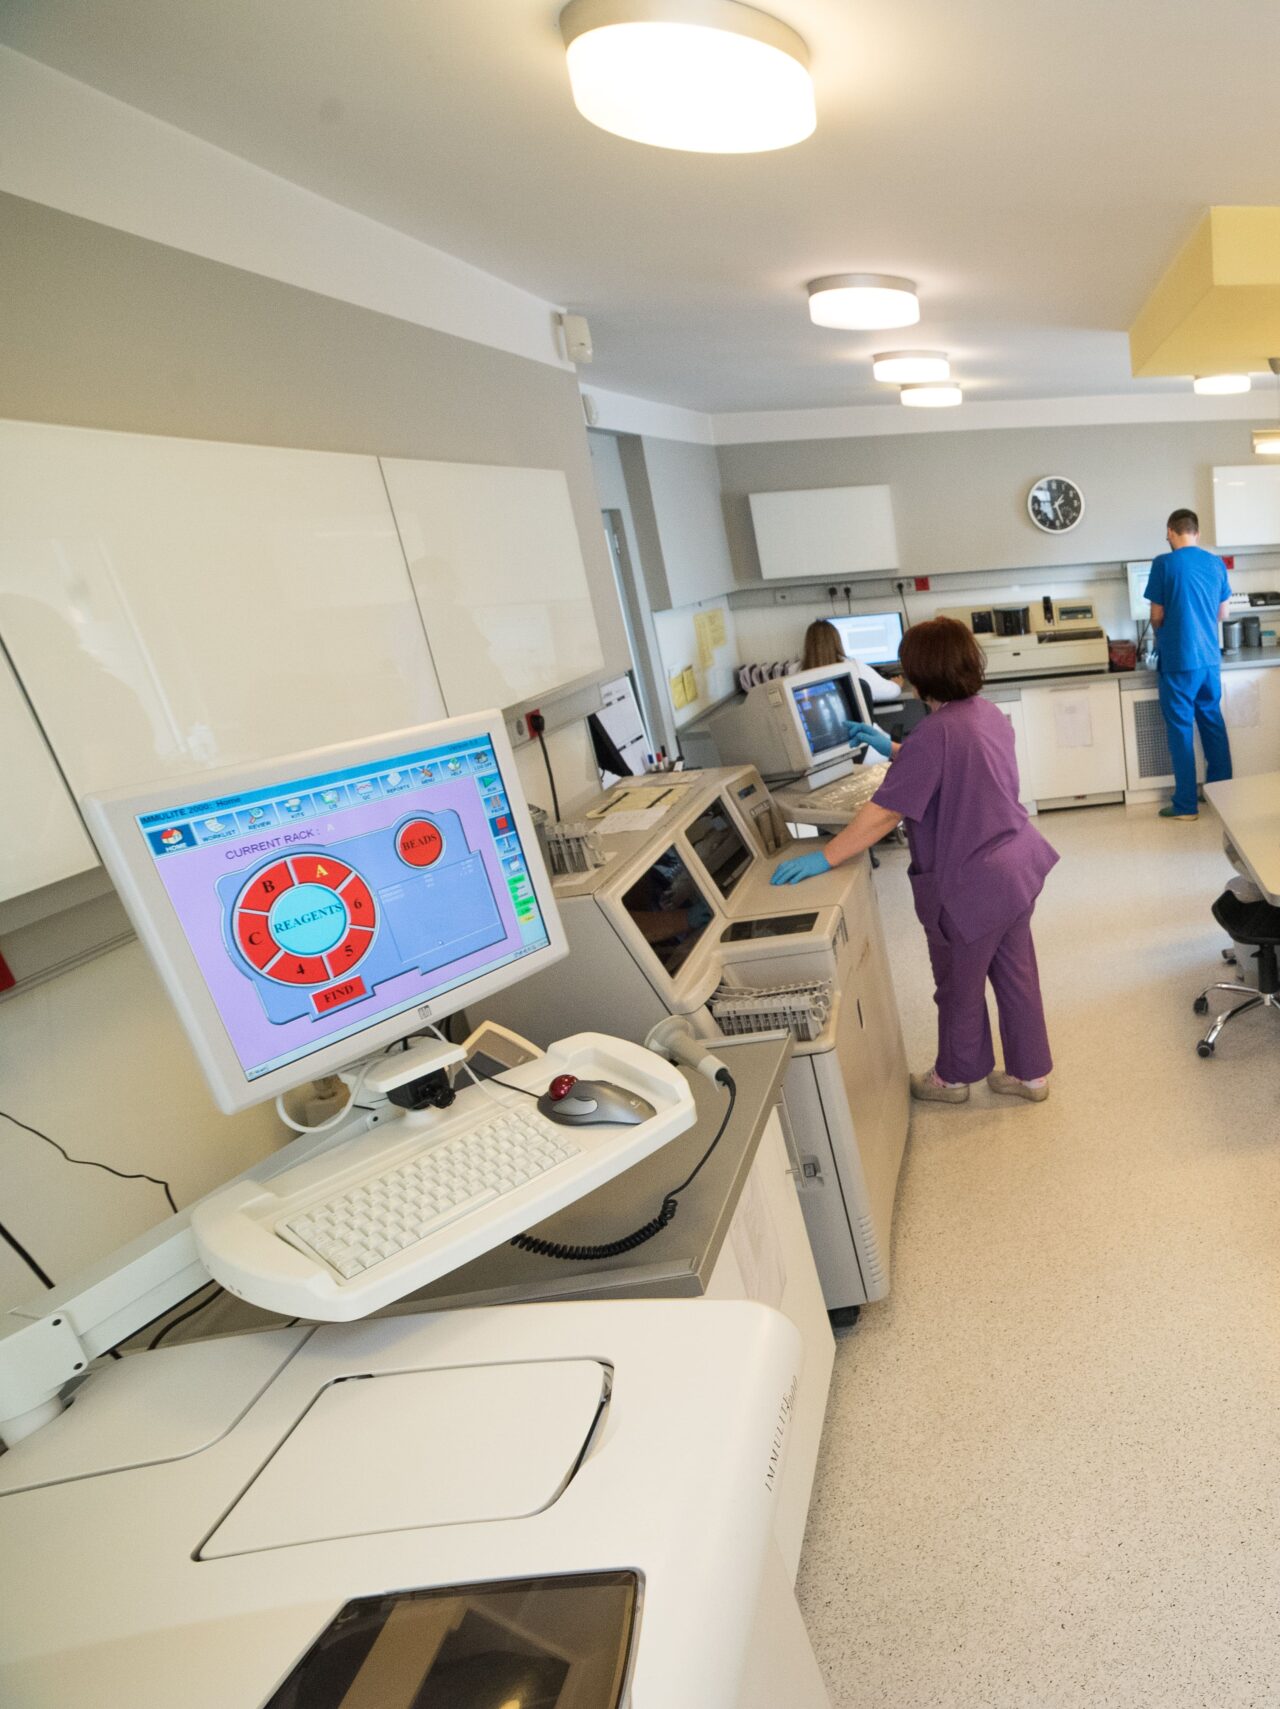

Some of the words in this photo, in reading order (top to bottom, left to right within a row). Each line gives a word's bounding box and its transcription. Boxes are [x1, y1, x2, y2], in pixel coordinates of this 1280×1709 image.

[140, 808, 186, 825] IMMULITE
[216, 797, 242, 807] Home
[248, 820, 272, 831] REVIEW
[202, 829, 237, 842] WORKLIST
[402, 833, 437, 851] BEADS
[225, 837, 283, 860] CURRENT
[315, 864, 328, 878] A
[262, 880, 275, 894] B
[353, 899, 363, 910] 6
[273, 903, 343, 934] REAGENTS
[248, 931, 263, 946] C
[345, 945, 354, 957] 5
[323, 984, 354, 1003] FIND
